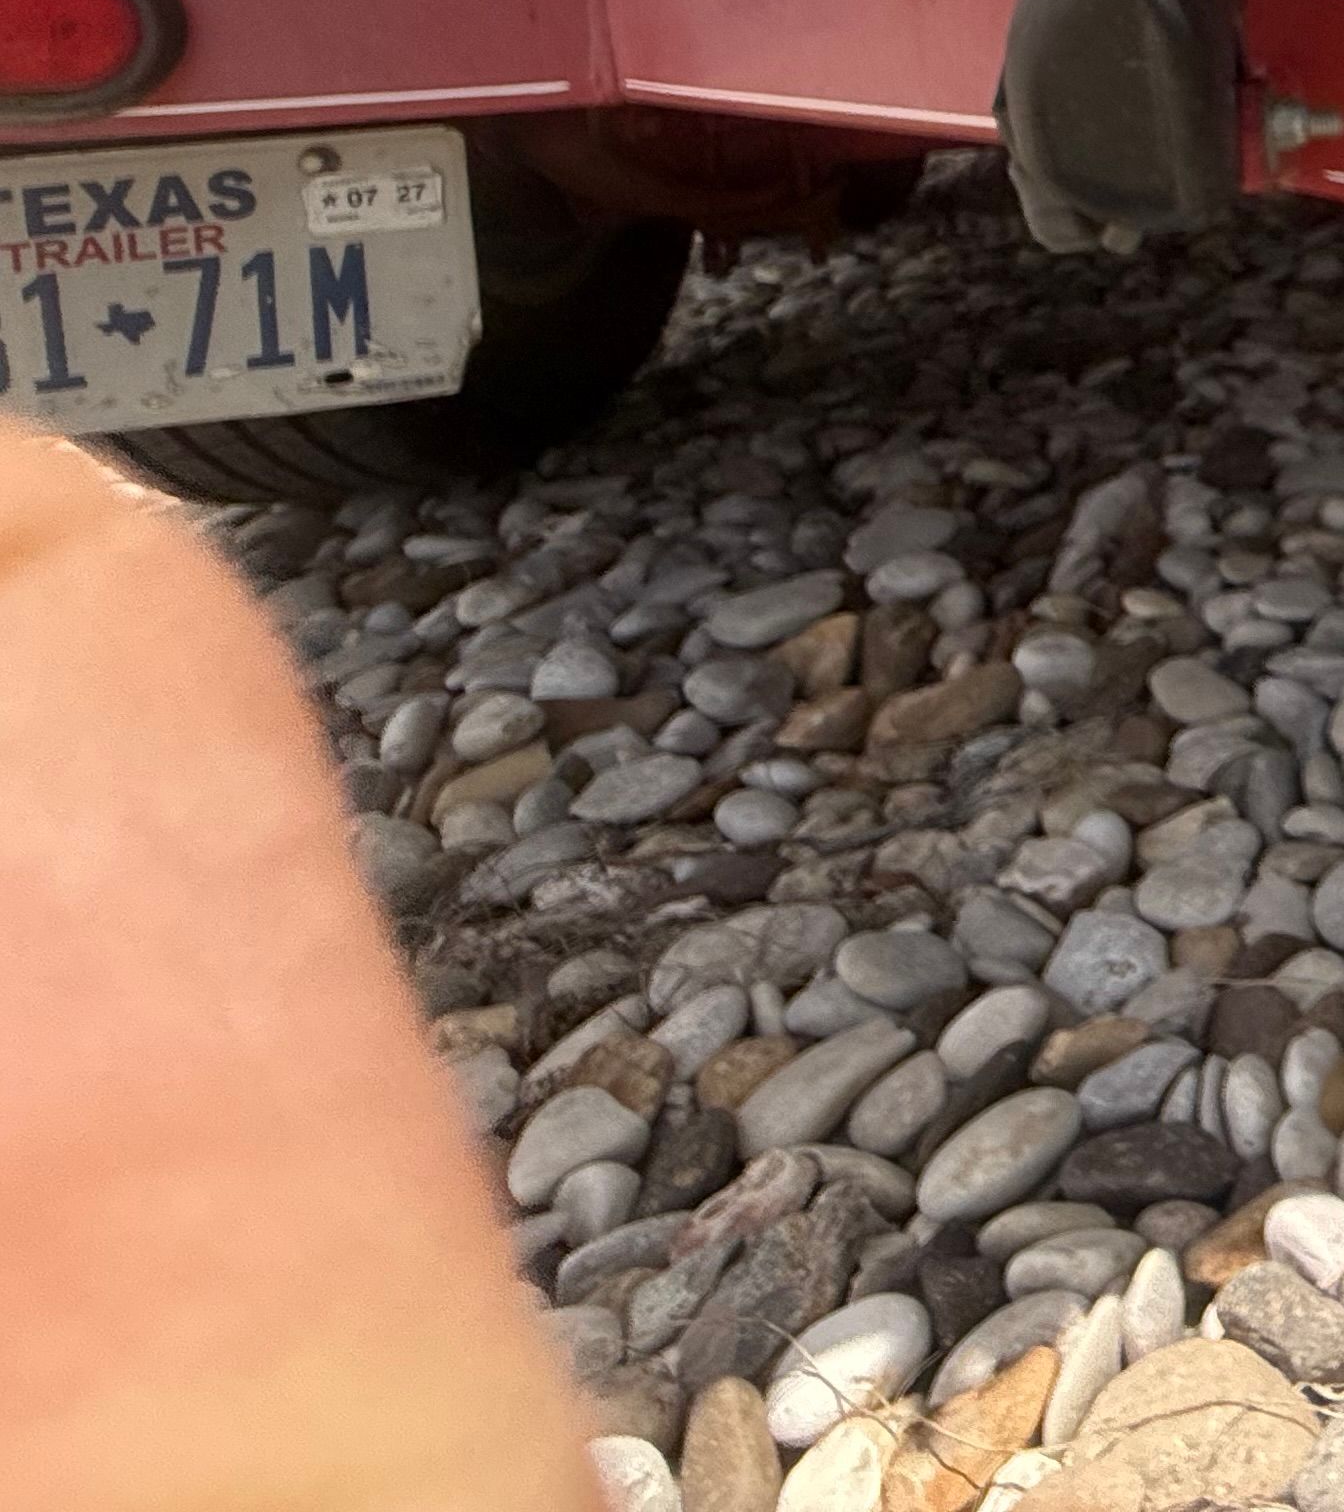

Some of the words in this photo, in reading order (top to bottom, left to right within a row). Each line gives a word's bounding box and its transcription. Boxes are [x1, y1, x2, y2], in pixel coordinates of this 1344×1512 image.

[0, 168, 257, 237] EXAS
[347, 185, 379, 208] 07
[397, 183, 427, 204] 27
[0, 223, 227, 273] TRAILER
[0, 273, 88, 394] 1
